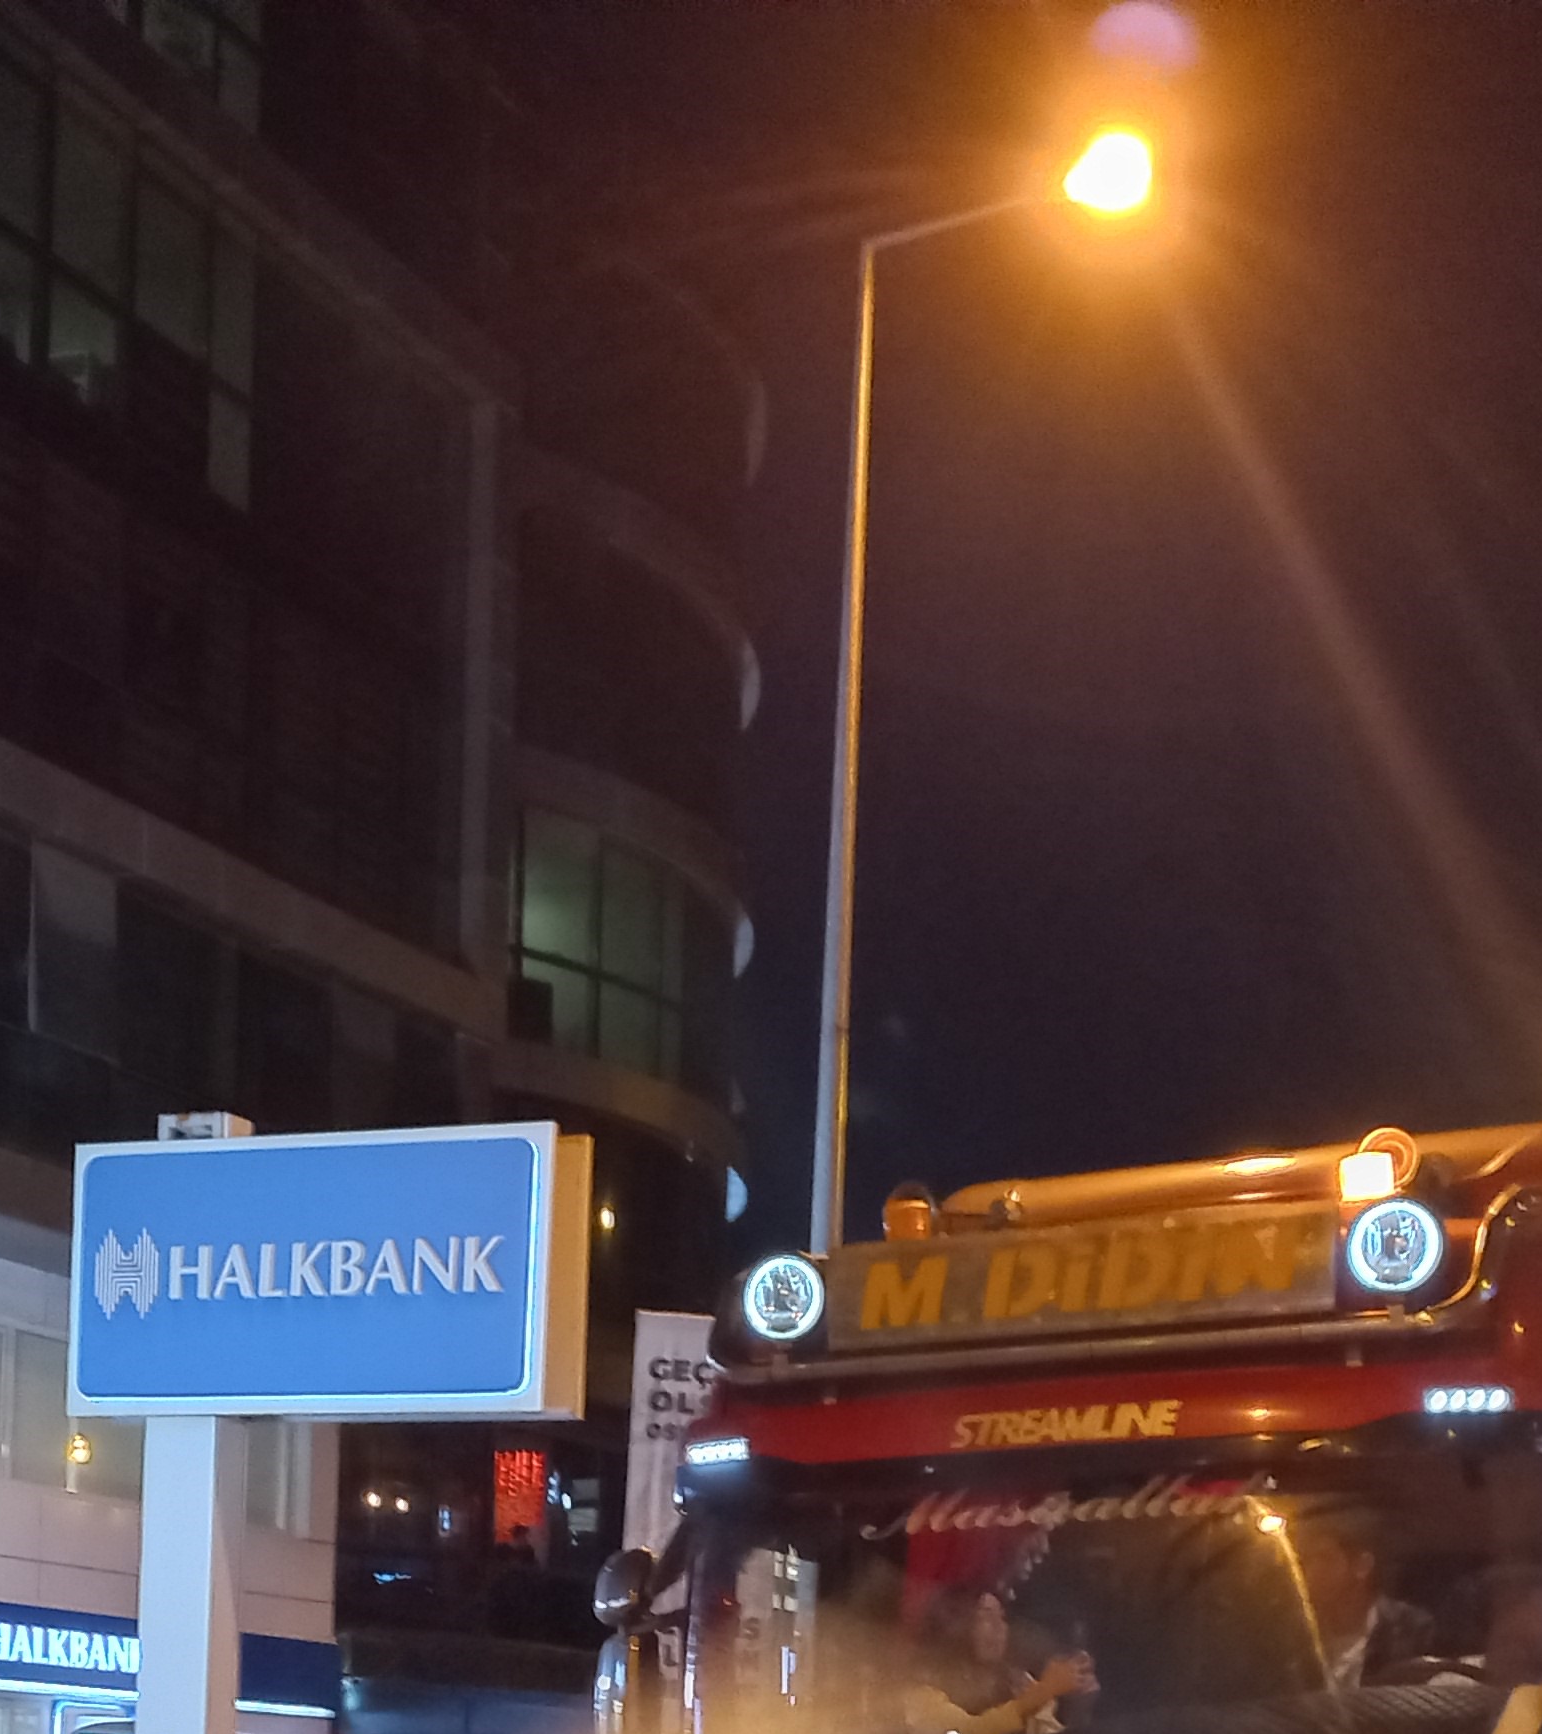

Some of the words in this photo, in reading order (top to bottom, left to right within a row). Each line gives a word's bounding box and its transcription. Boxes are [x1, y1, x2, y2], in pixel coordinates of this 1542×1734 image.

[166, 1235, 506, 1301] HALKBANK
[861, 1255, 949, 1331] M
[951, 1399, 1183, 1448] STREAMLINE
